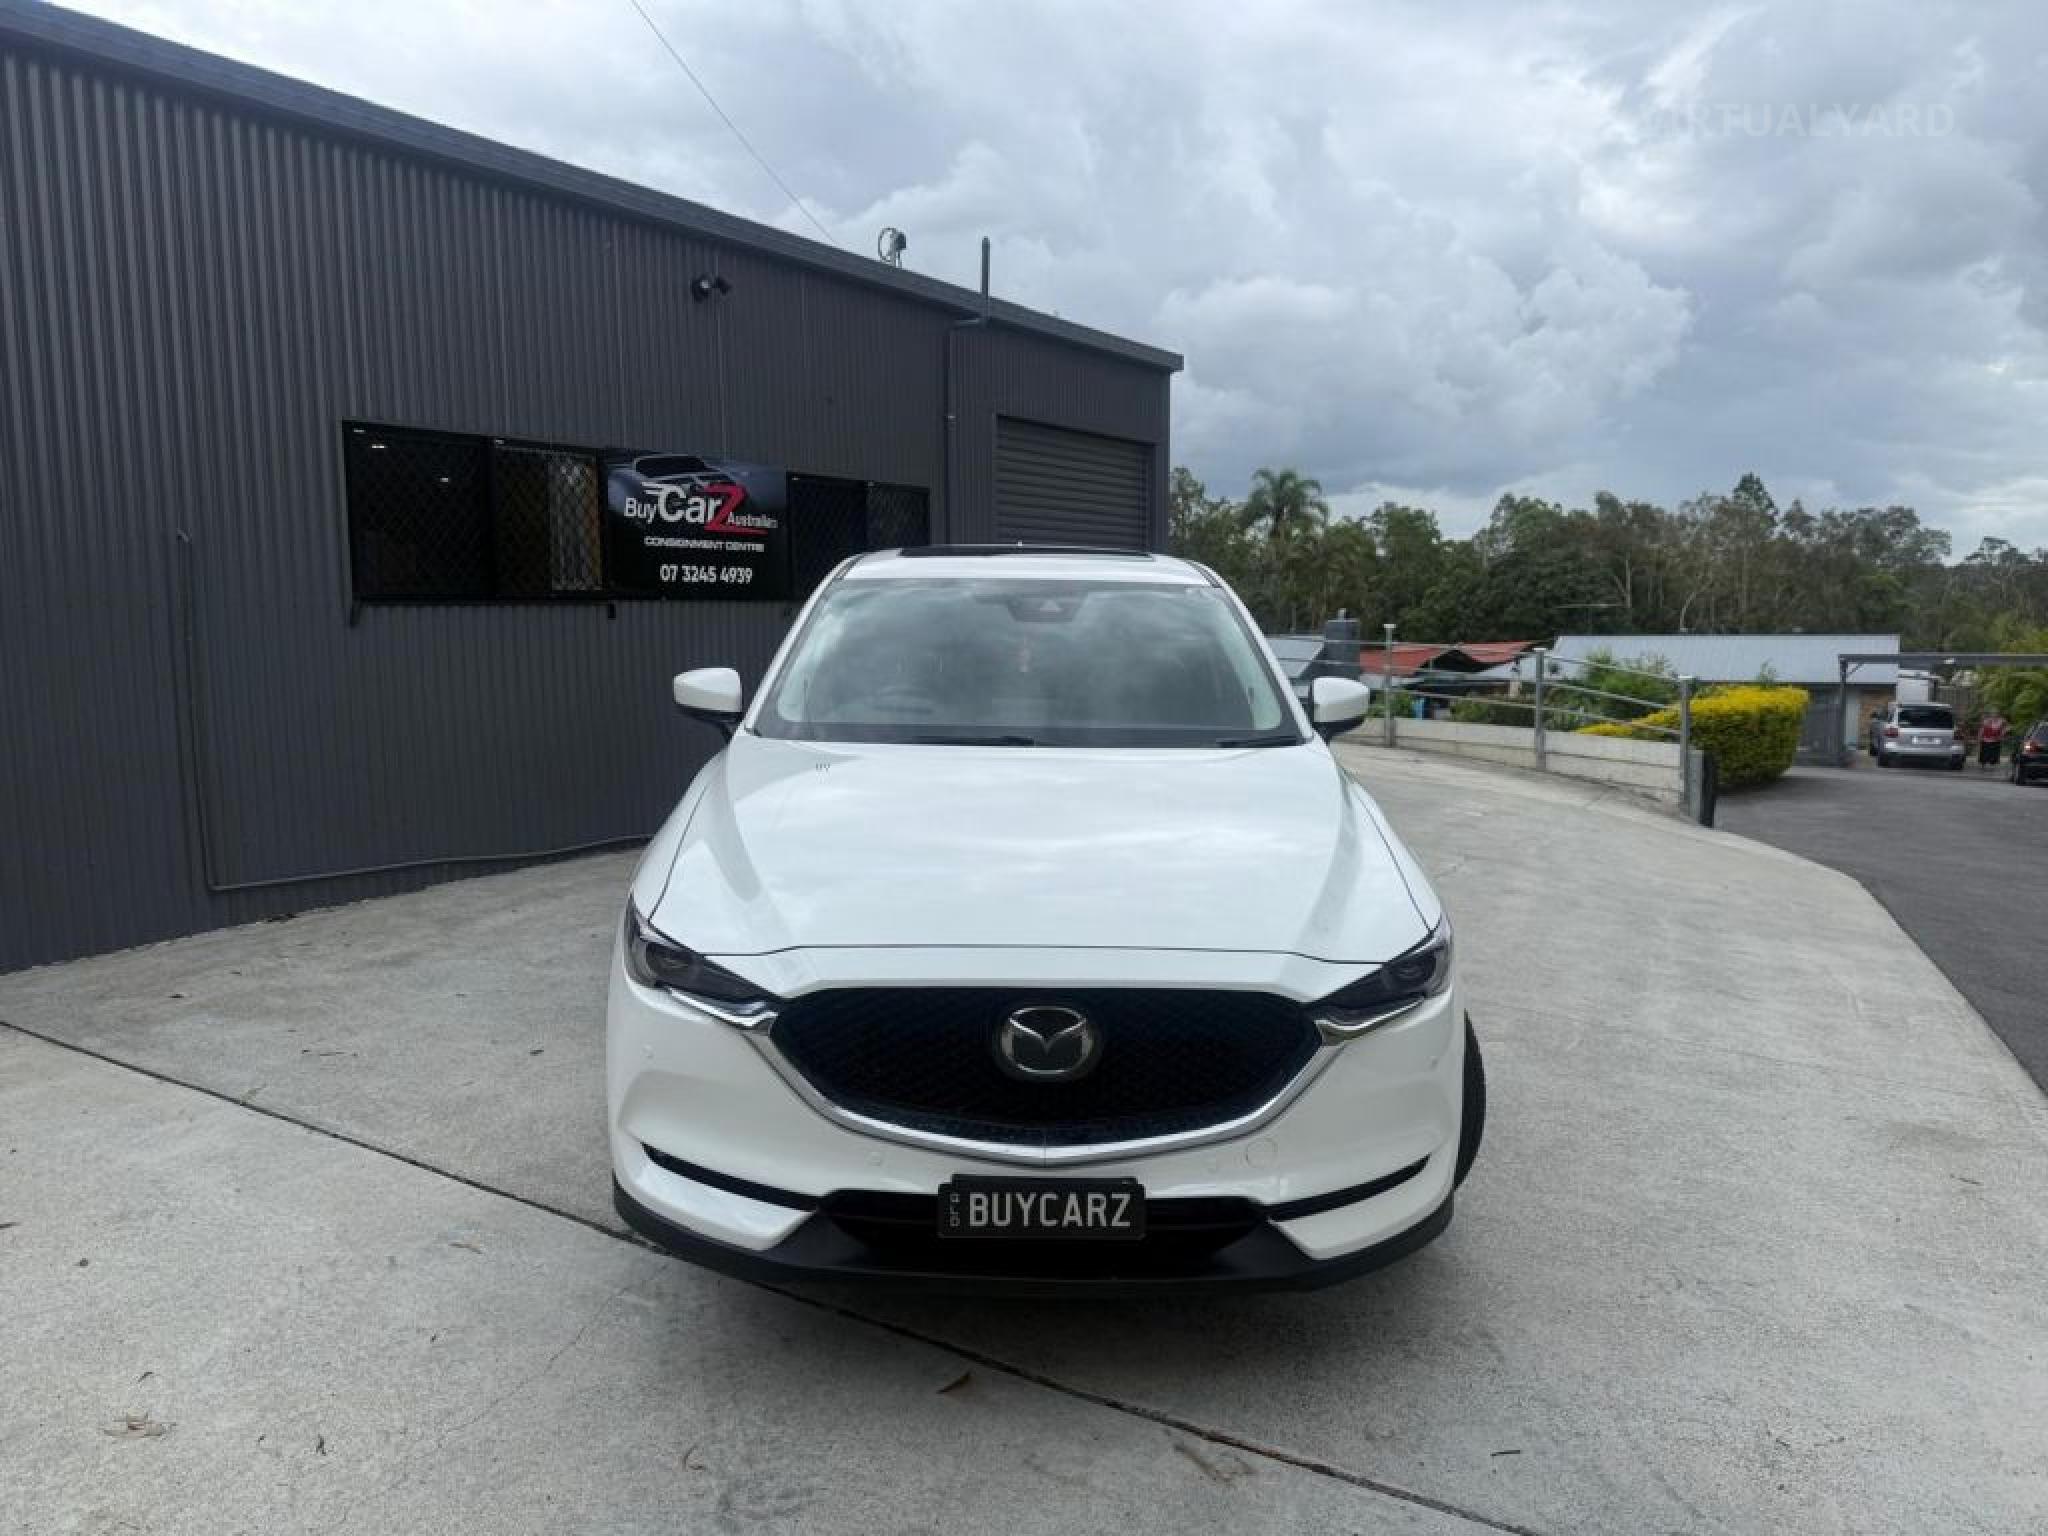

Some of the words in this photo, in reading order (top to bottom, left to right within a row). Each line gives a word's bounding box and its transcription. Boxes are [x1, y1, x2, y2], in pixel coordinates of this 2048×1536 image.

[660, 564, 678, 582] 07
[682, 565, 717, 582] 3245
[720, 567, 753, 584] 4939
[969, 1192, 1131, 1227] BUYCARZ
